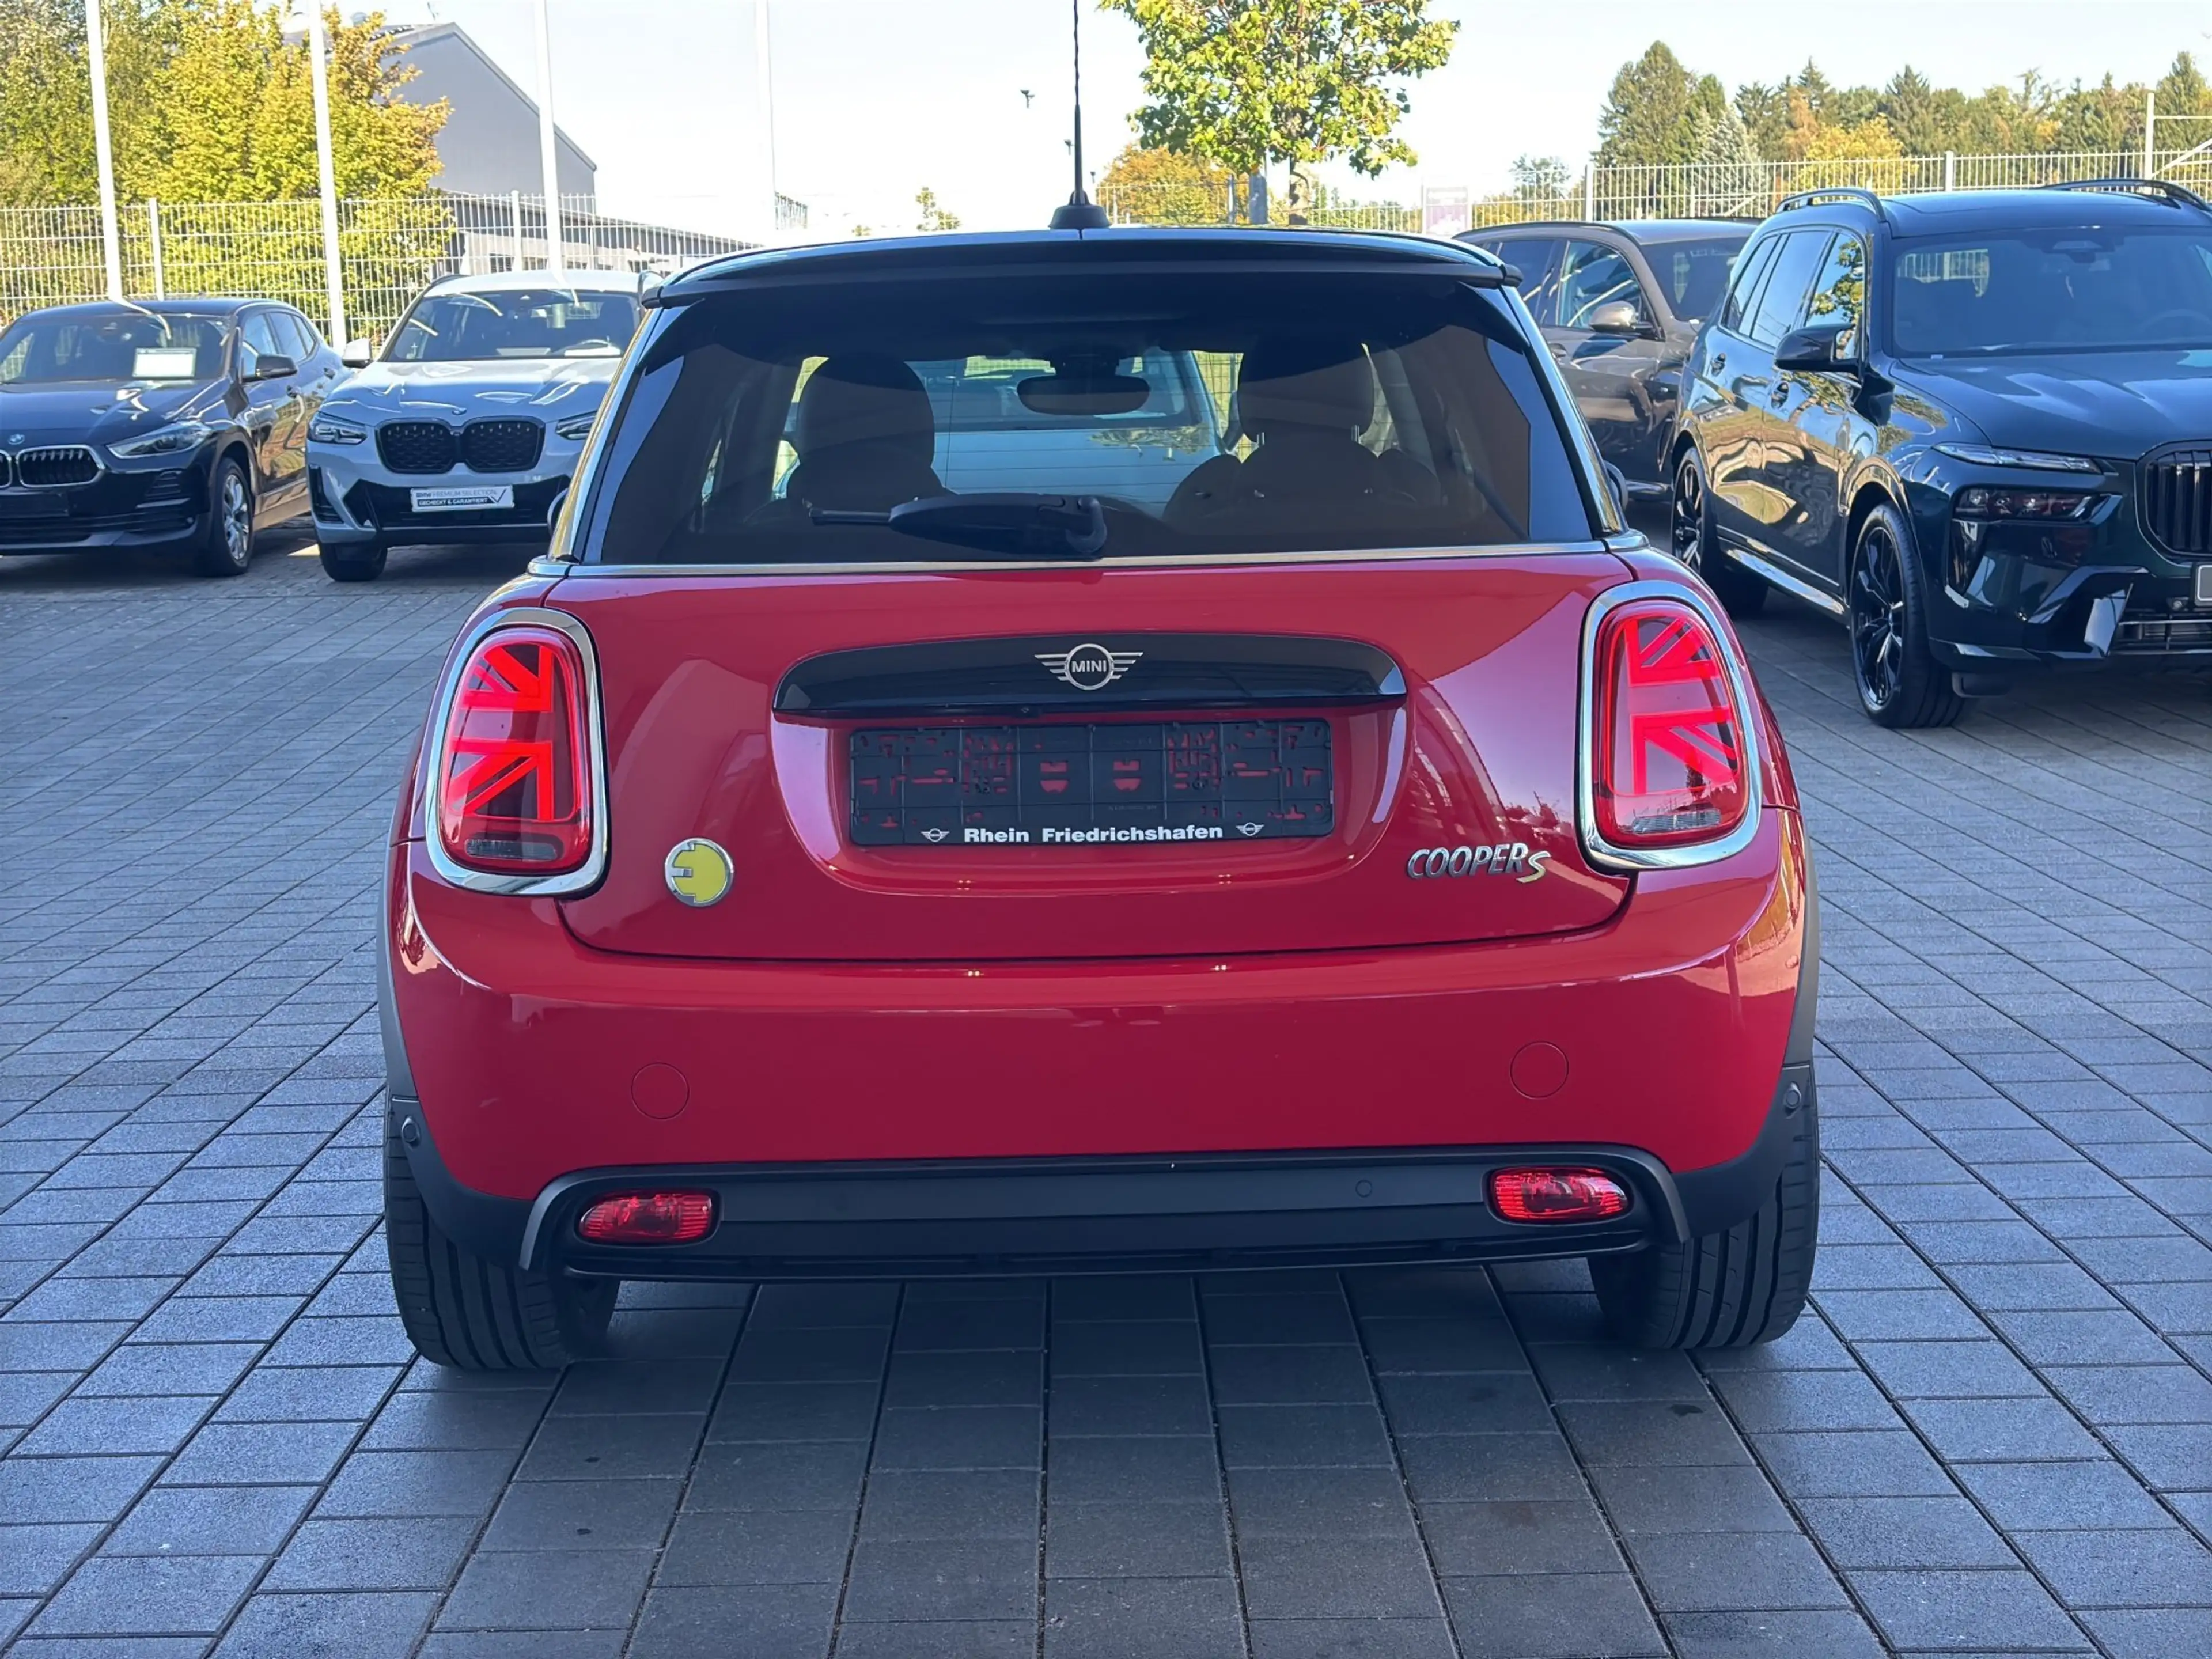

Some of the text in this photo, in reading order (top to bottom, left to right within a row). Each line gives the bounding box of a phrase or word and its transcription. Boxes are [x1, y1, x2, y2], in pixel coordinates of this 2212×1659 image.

[1071, 660, 1107, 673] MINI
[964, 824, 1223, 843] Rhein Friedrichshafen
[1407, 842, 1552, 884] COOPER S
